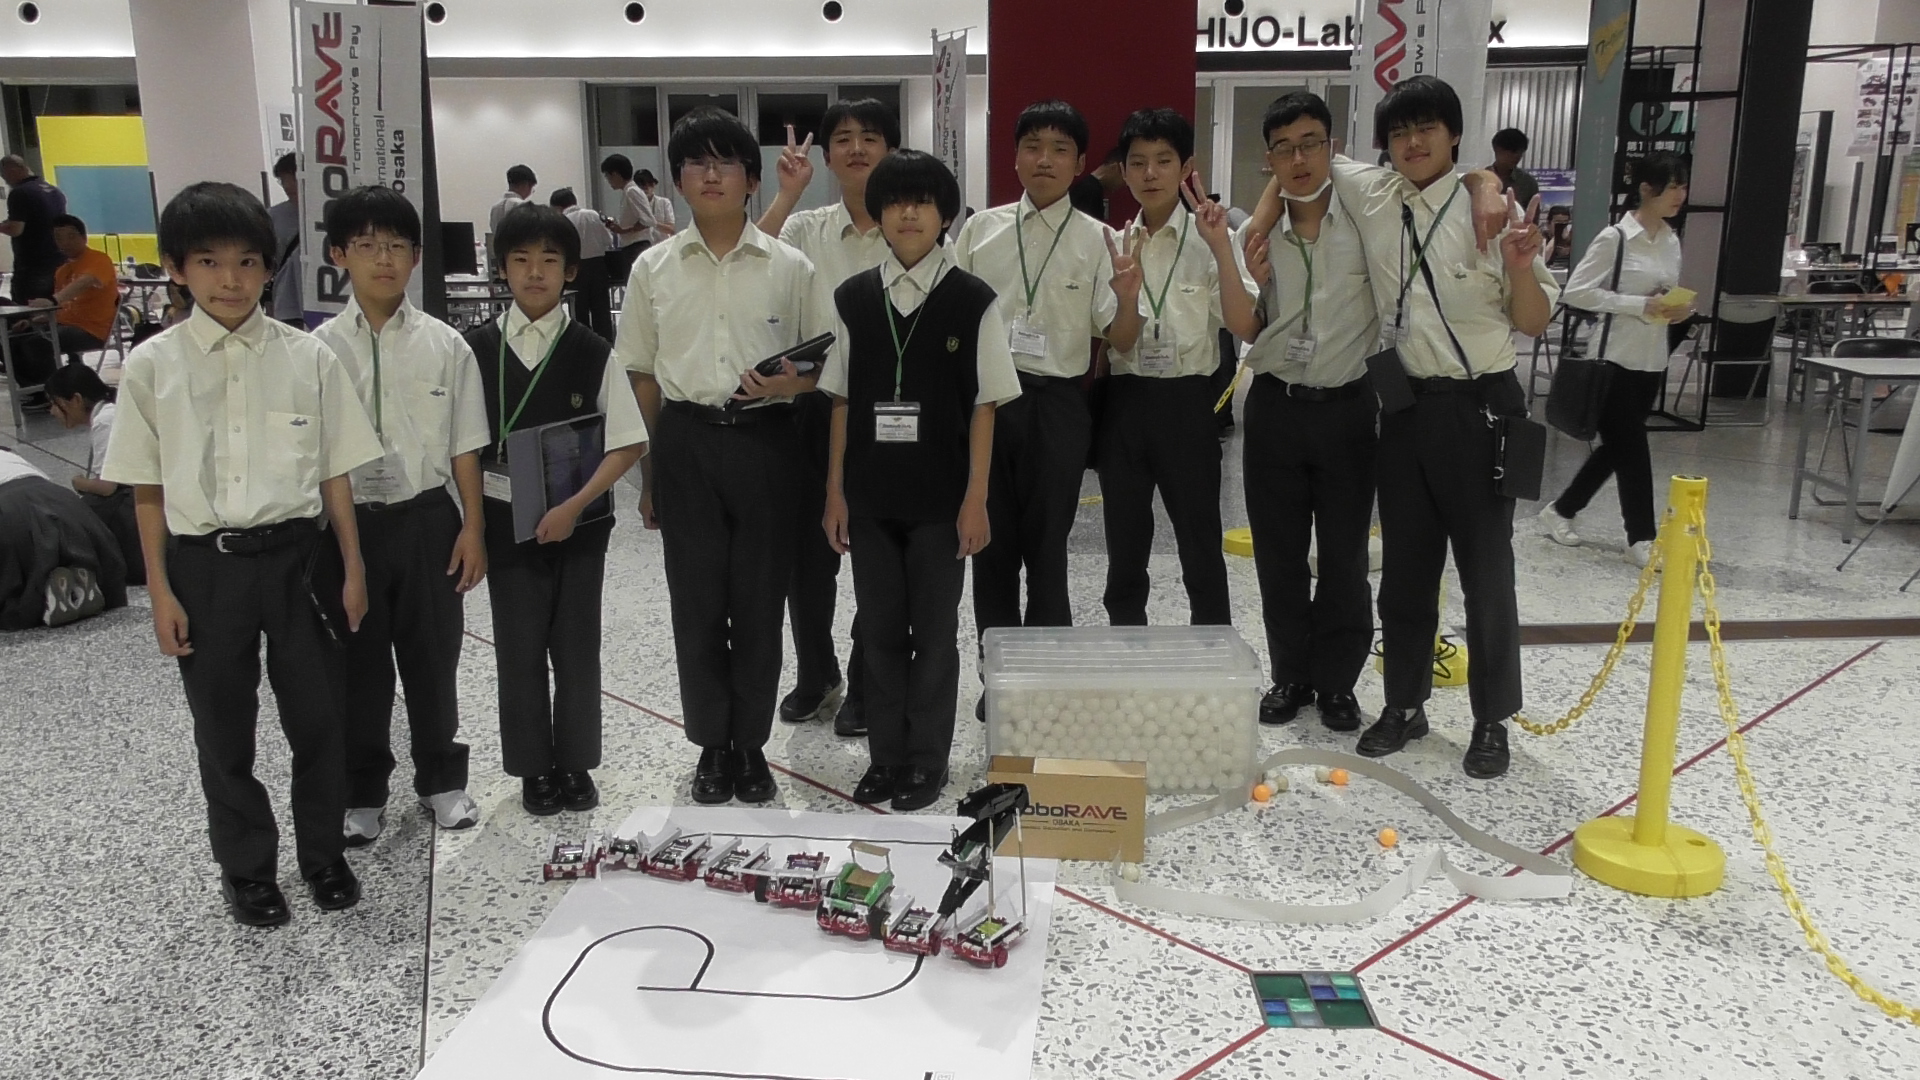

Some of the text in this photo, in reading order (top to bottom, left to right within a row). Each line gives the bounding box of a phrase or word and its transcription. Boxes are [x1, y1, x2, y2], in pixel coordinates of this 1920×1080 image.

[349, 25, 361, 175] Tomorrow's Pay
[1021, 802, 1128, 820] oboRAVE
